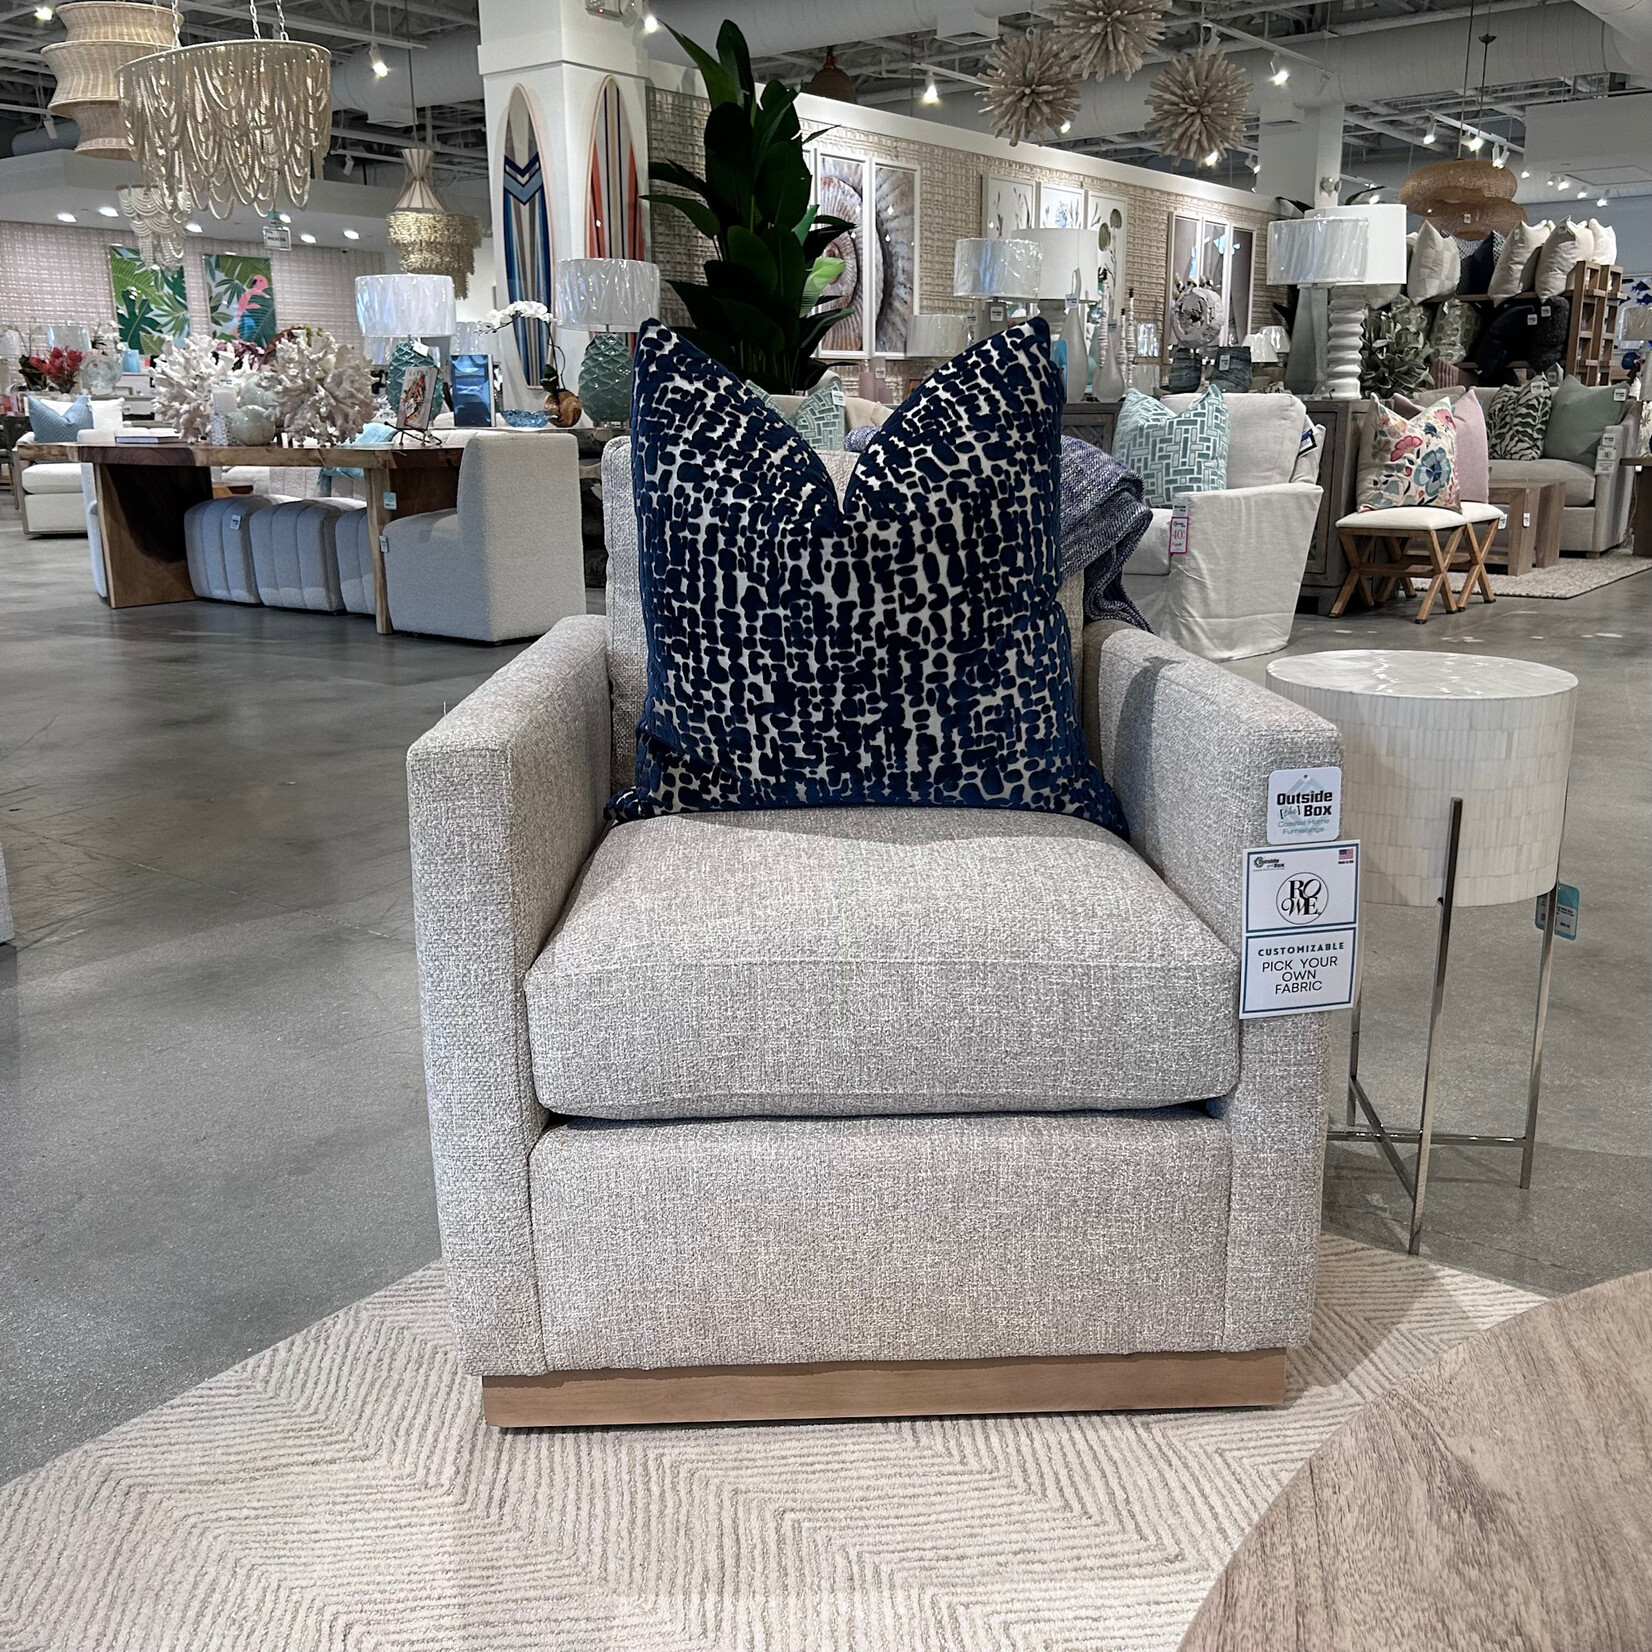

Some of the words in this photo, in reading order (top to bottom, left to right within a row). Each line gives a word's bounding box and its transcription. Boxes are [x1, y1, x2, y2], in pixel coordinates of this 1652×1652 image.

[1276, 790, 1333, 806] Outside
[1304, 805, 1332, 817] Box
[1258, 942, 1344, 957] CUSTOMIZABLE
[1262, 959, 1293, 973] PICK
[1299, 956, 1338, 969] YOUR
[1281, 969, 1317, 982] OWN
[1275, 980, 1323, 995] FABRIC
